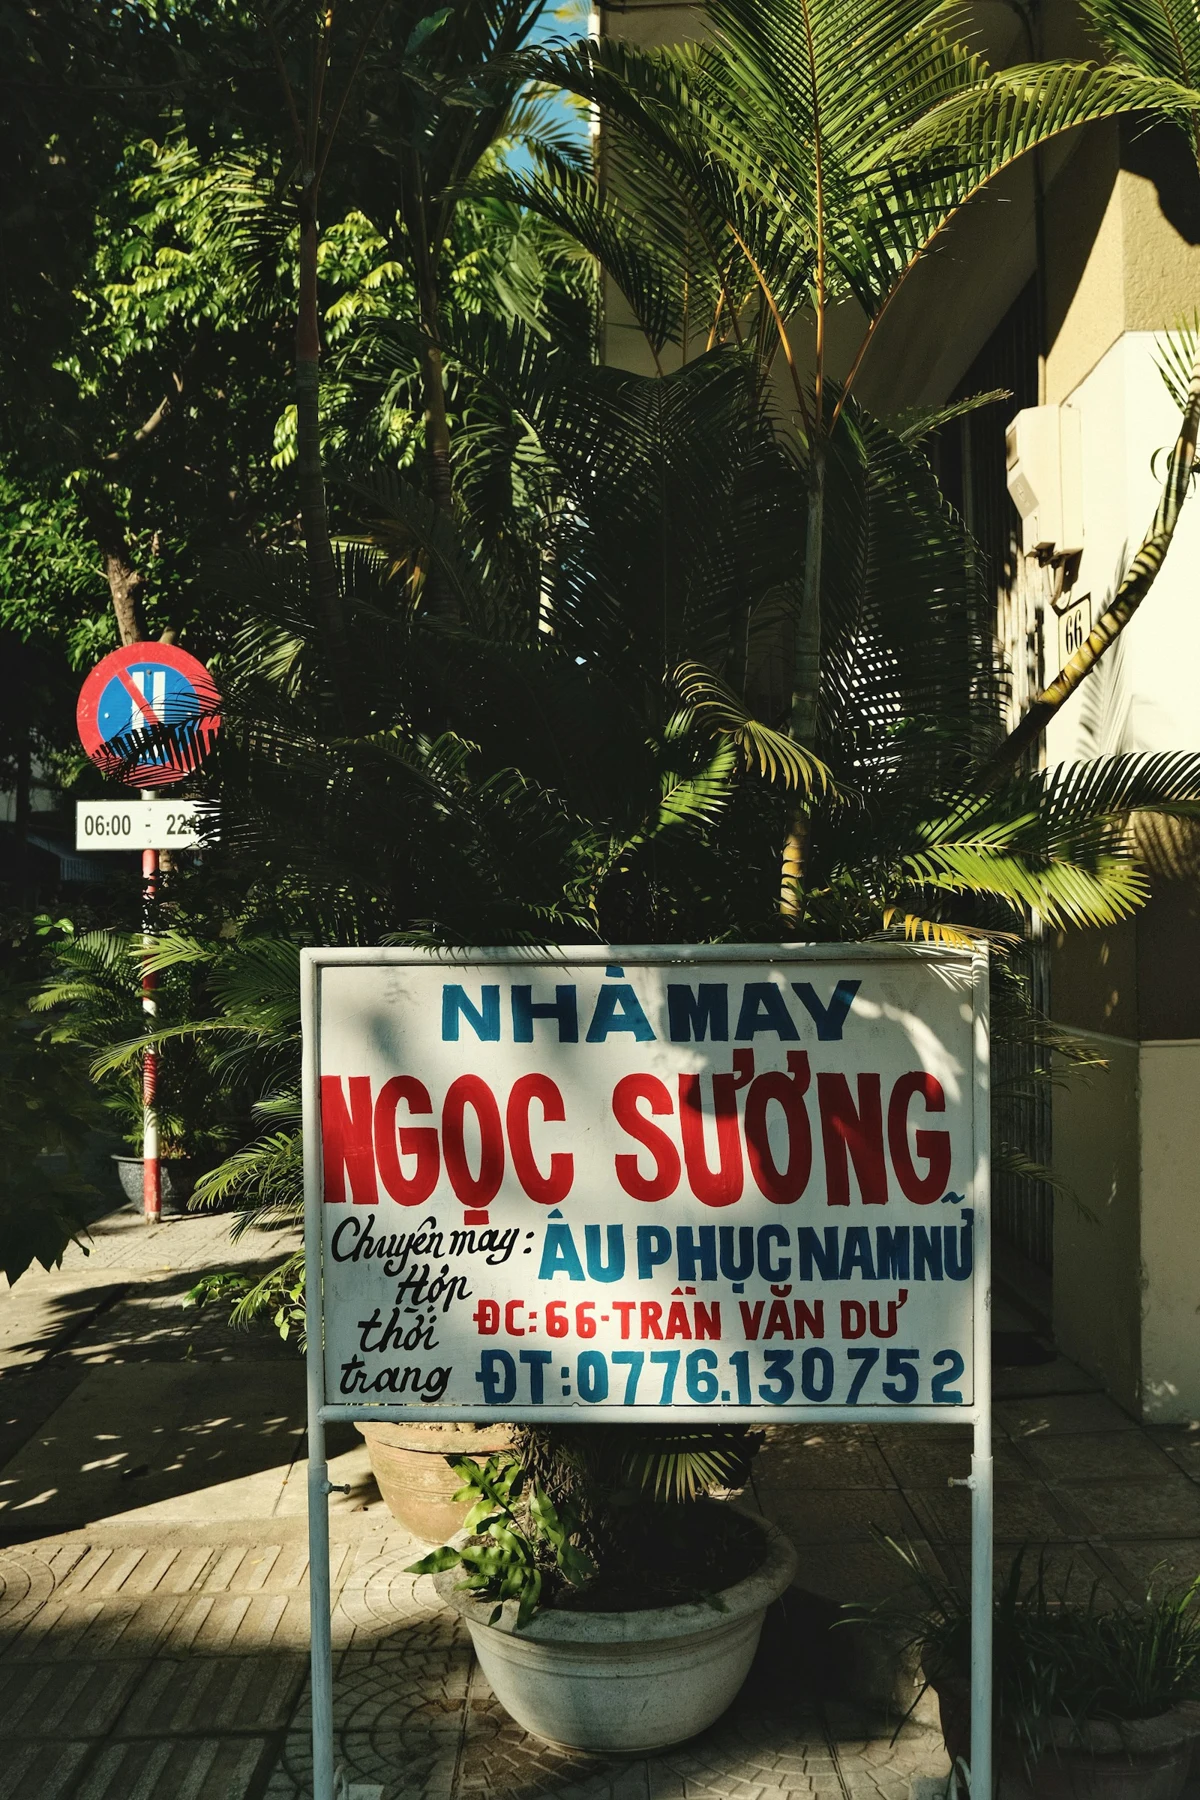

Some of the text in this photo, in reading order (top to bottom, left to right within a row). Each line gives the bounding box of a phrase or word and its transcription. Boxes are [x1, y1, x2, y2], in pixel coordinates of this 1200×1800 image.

[1065, 609, 1082, 655] 66
[84, 815, 131, 835] 06:00
[442, 965, 862, 1043] NHÀ MAY
[320, 1048, 951, 1225] NGỌC SƯƠNG
[332, 1214, 444, 1277] Chuyên
[538, 1208, 625, 1283] ÂU
[637, 1224, 792, 1293] PHỤC
[357, 1306, 439, 1353] thời
[739, 1284, 824, 1340] VĂN
[840, 1289, 908, 1339] DƯ
[339, 1354, 452, 1403] trang
